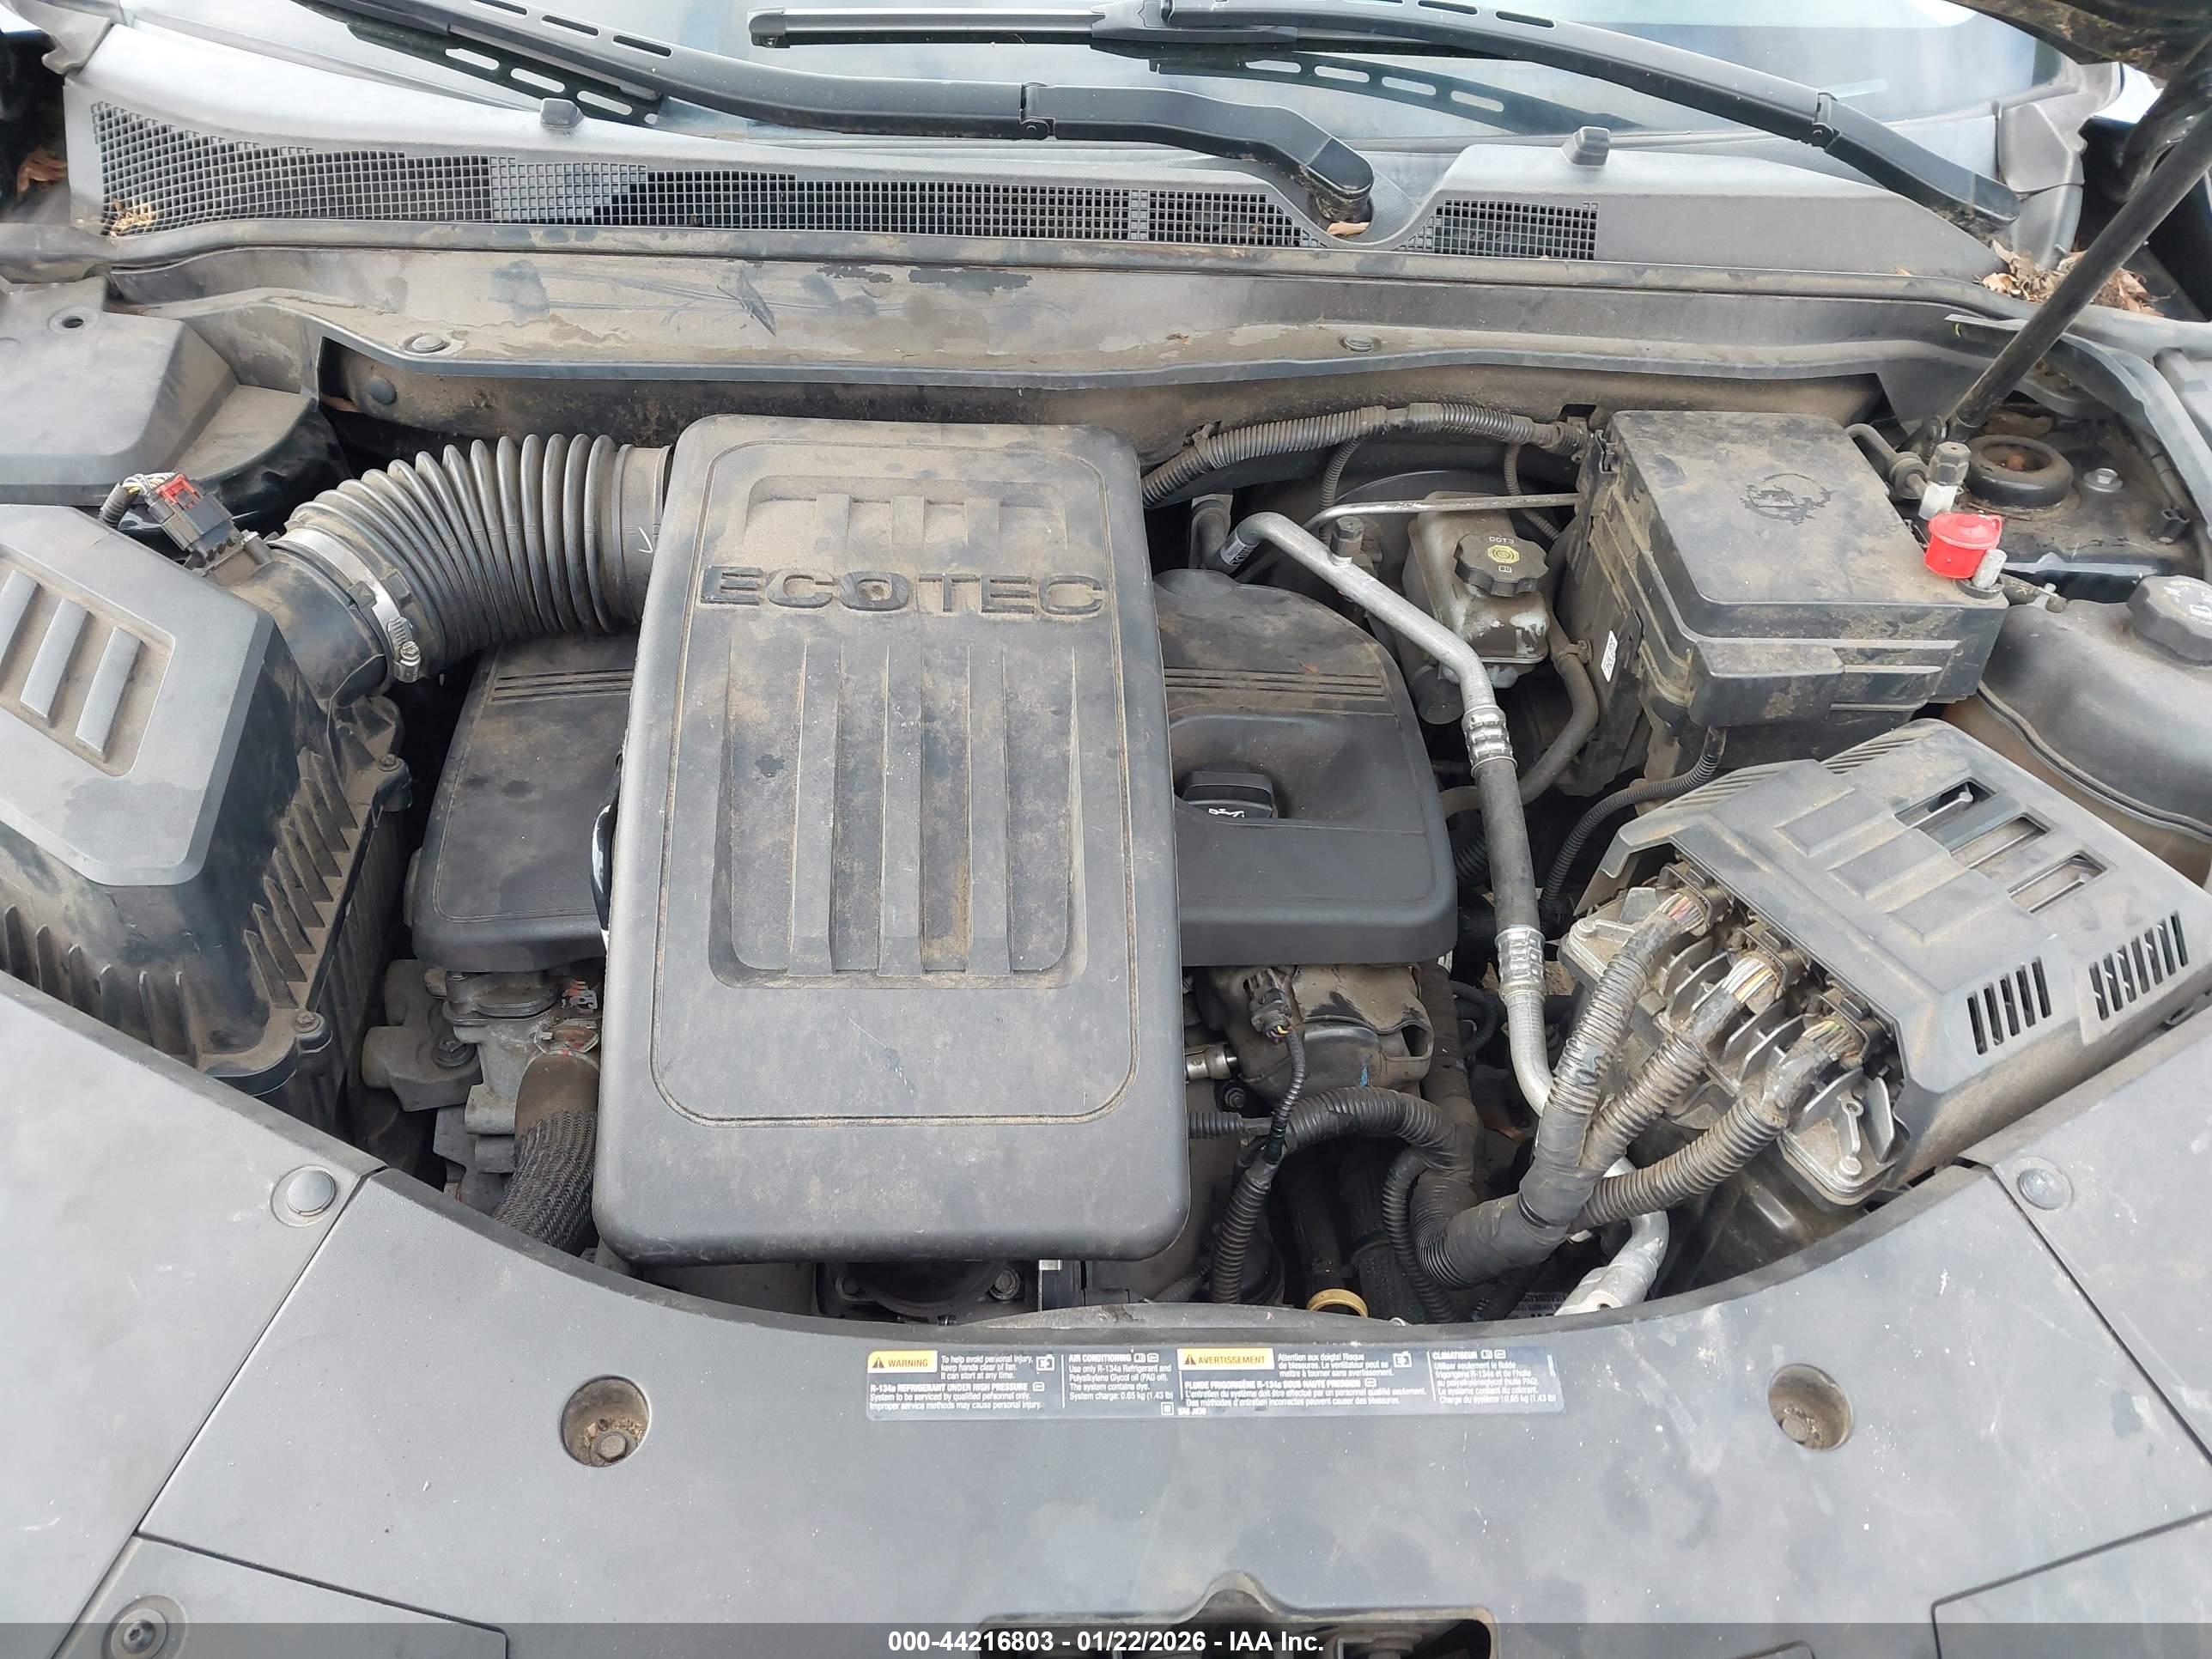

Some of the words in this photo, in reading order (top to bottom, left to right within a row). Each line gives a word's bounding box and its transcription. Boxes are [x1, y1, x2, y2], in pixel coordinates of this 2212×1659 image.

[699, 565, 1105, 617] ECOTEC
[951, 1356, 964, 1365] help
[985, 1355, 1012, 1364] personal
[1069, 1353, 1081, 1362] AIR
[1082, 1353, 1132, 1362] CONDITIONING
[1198, 1355, 1265, 1364] AVERTISSEMENT
[1342, 1353, 1364, 1362] Risque
[1432, 1351, 1477, 1360] CLIMATISEUR
[888, 1358, 928, 1368] WARNING
[941, 1364, 957, 1372] keep
[997, 1363, 1004, 1371] of
[1069, 1364, 1081, 1373] Use
[1083, 1364, 1096, 1374] only
[1097, 1364, 1121, 1373] R-134a
[1122, 1364, 1158, 1374] Refrigerant
[1159, 1364, 1171, 1372] and
[985, 1372, 997, 1381] any
[1109, 1373, 1130, 1382] Glycol
[1139, 1373, 1156, 1382] (PAG
[870, 1384, 896, 1393] R-134a
[897, 1383, 945, 1392] REFRIGERANT
[946, 1382, 972, 1391] UNDER
[972, 1382, 991, 1391] HIGH
[991, 1382, 1029, 1391] PRESSURE
[1084, 1382, 1106, 1391] system
[1136, 1382, 1150, 1391] dye.
[870, 1393, 895, 1402] System
[943, 1393, 951, 1401] by
[952, 1392, 981, 1401] qualified
[981, 1392, 1014, 1401] personnel
[1015, 1392, 1031, 1401] only.
[1070, 1392, 1093, 1401] System
[1137, 1392, 1146, 1401] kg
[1220, 1389, 1230, 1398] du
[869, 1402, 899, 1412] Improper
[957, 1401, 970, 1410] may
[993, 1401, 1020, 1410] personal
